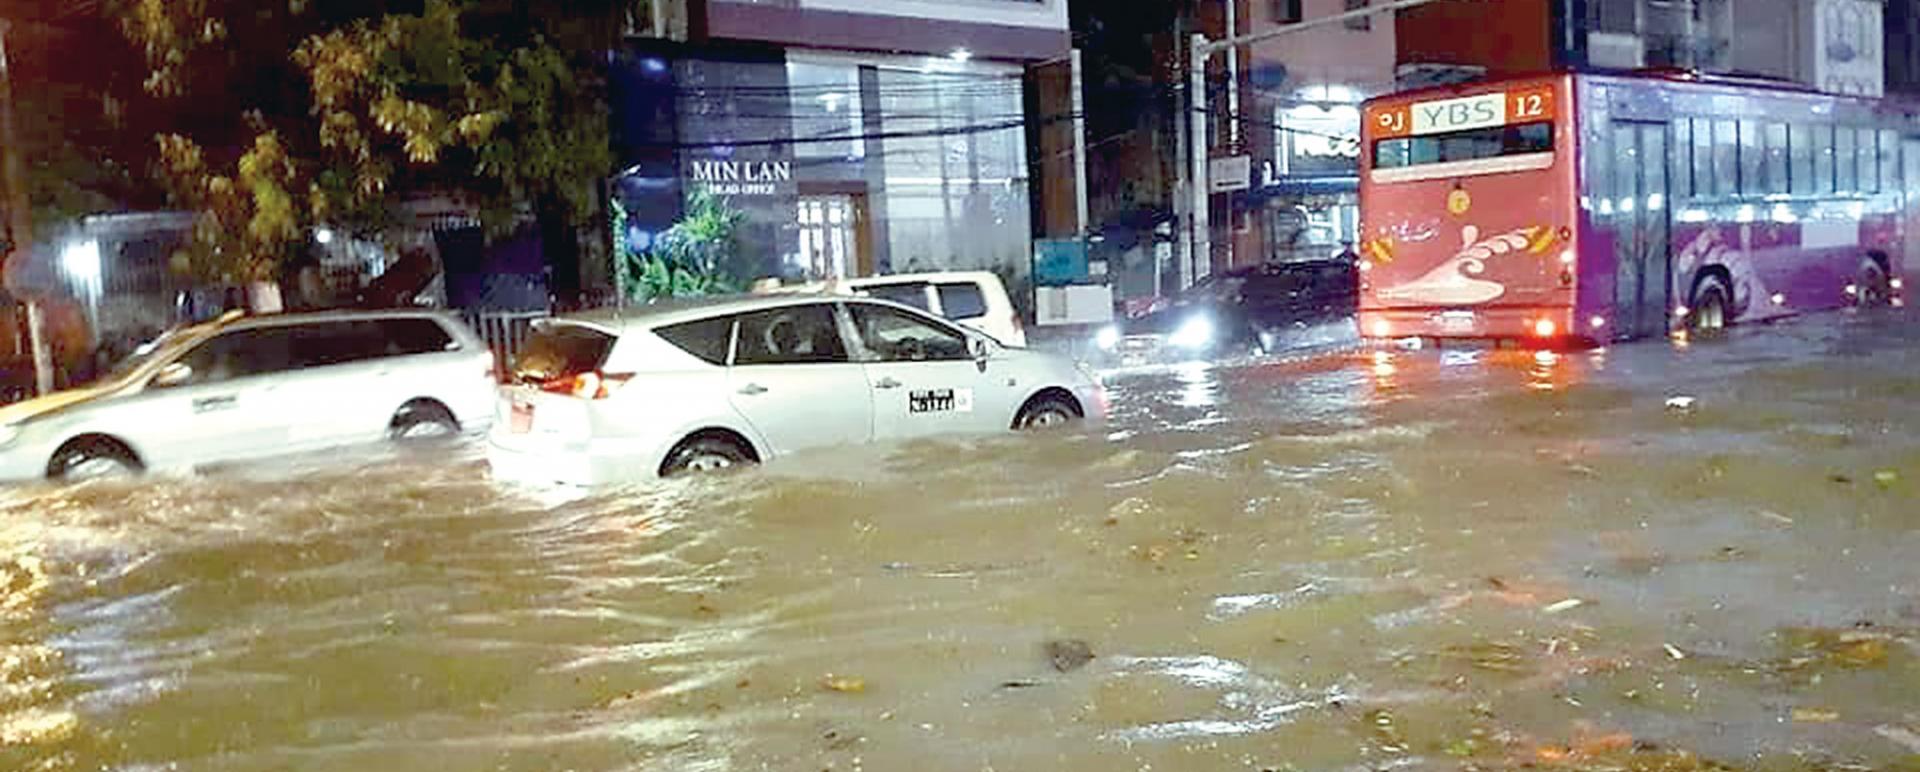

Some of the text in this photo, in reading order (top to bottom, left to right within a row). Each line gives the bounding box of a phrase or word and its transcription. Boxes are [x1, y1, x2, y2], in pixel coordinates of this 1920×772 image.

[1423, 100, 1496, 127] YBS
[1515, 94, 1543, 118] 12
[692, 160, 790, 181] MIN LAN
